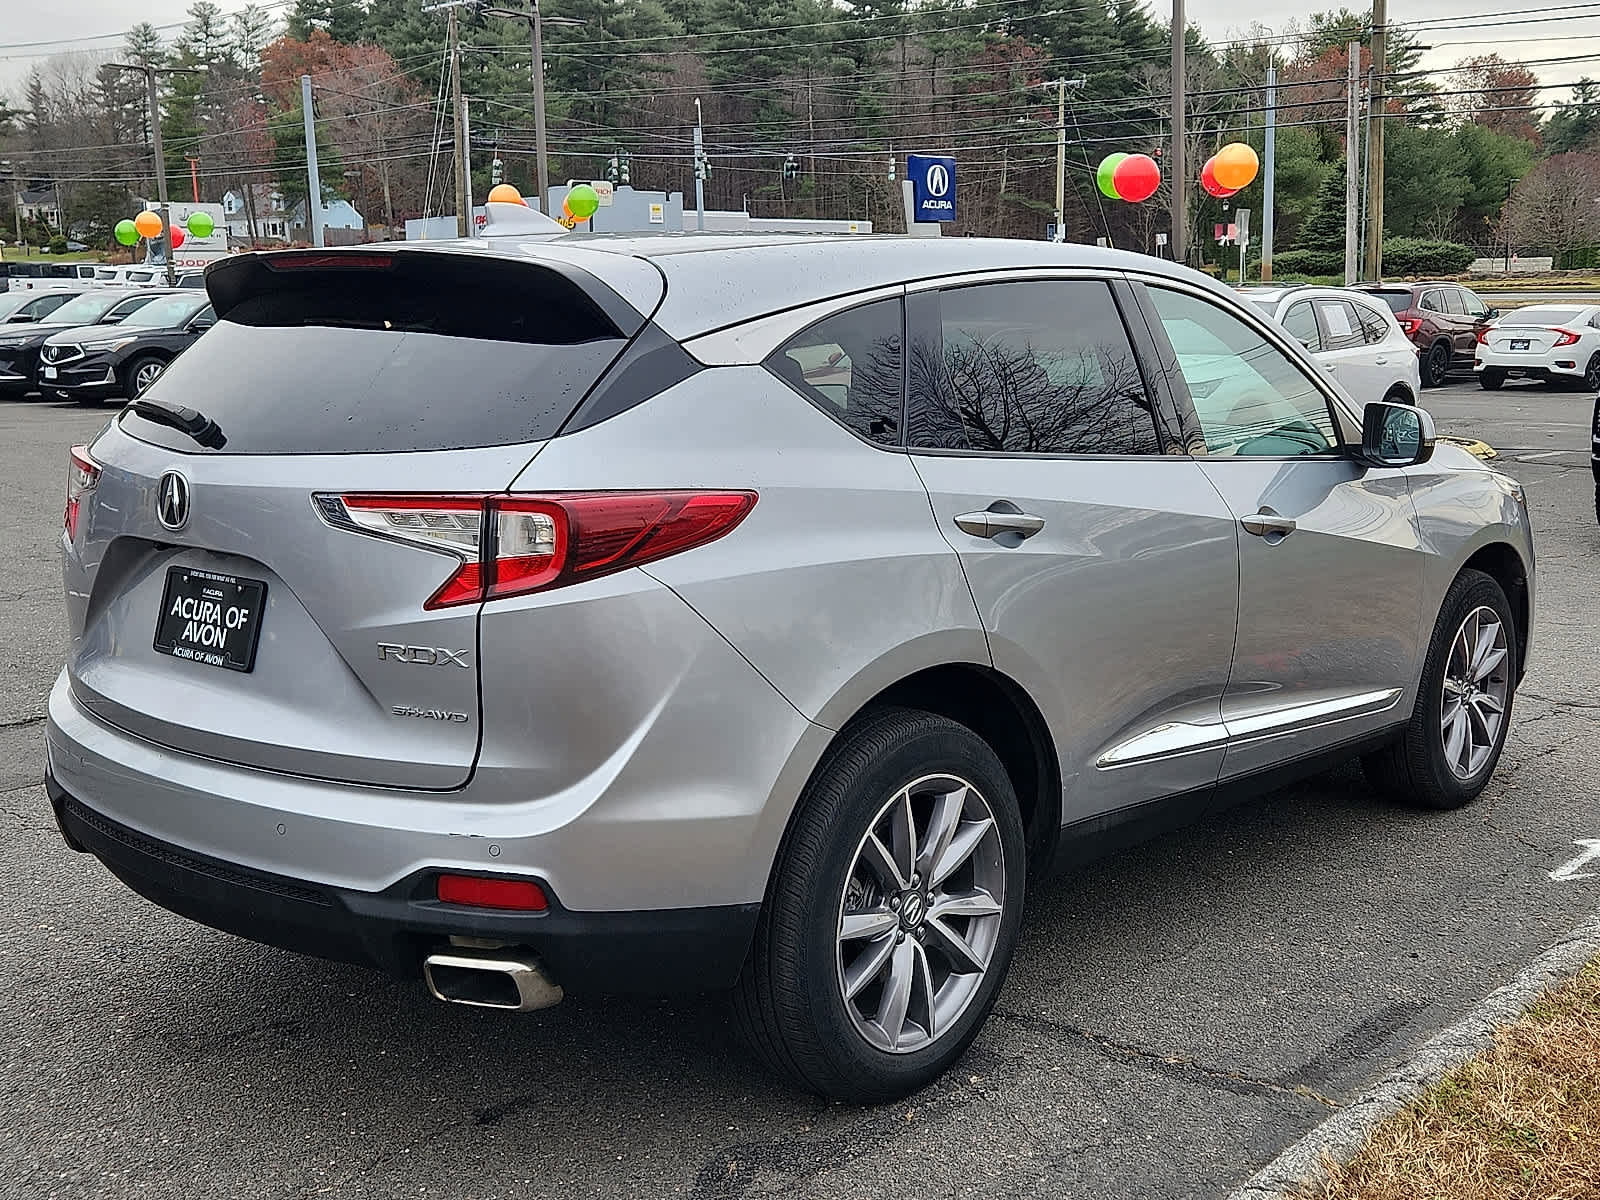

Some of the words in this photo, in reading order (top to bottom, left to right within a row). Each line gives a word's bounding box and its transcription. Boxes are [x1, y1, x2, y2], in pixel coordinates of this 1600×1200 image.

[921, 199, 953, 210] ACURA
[170, 595, 221, 626] ACURA
[225, 606, 249, 630] OF
[181, 620, 228, 649] AVON
[172, 646, 194, 659] ACURA
[194, 651, 205, 662] OF
[203, 653, 224, 666] AVON
[377, 641, 470, 669] RDX
